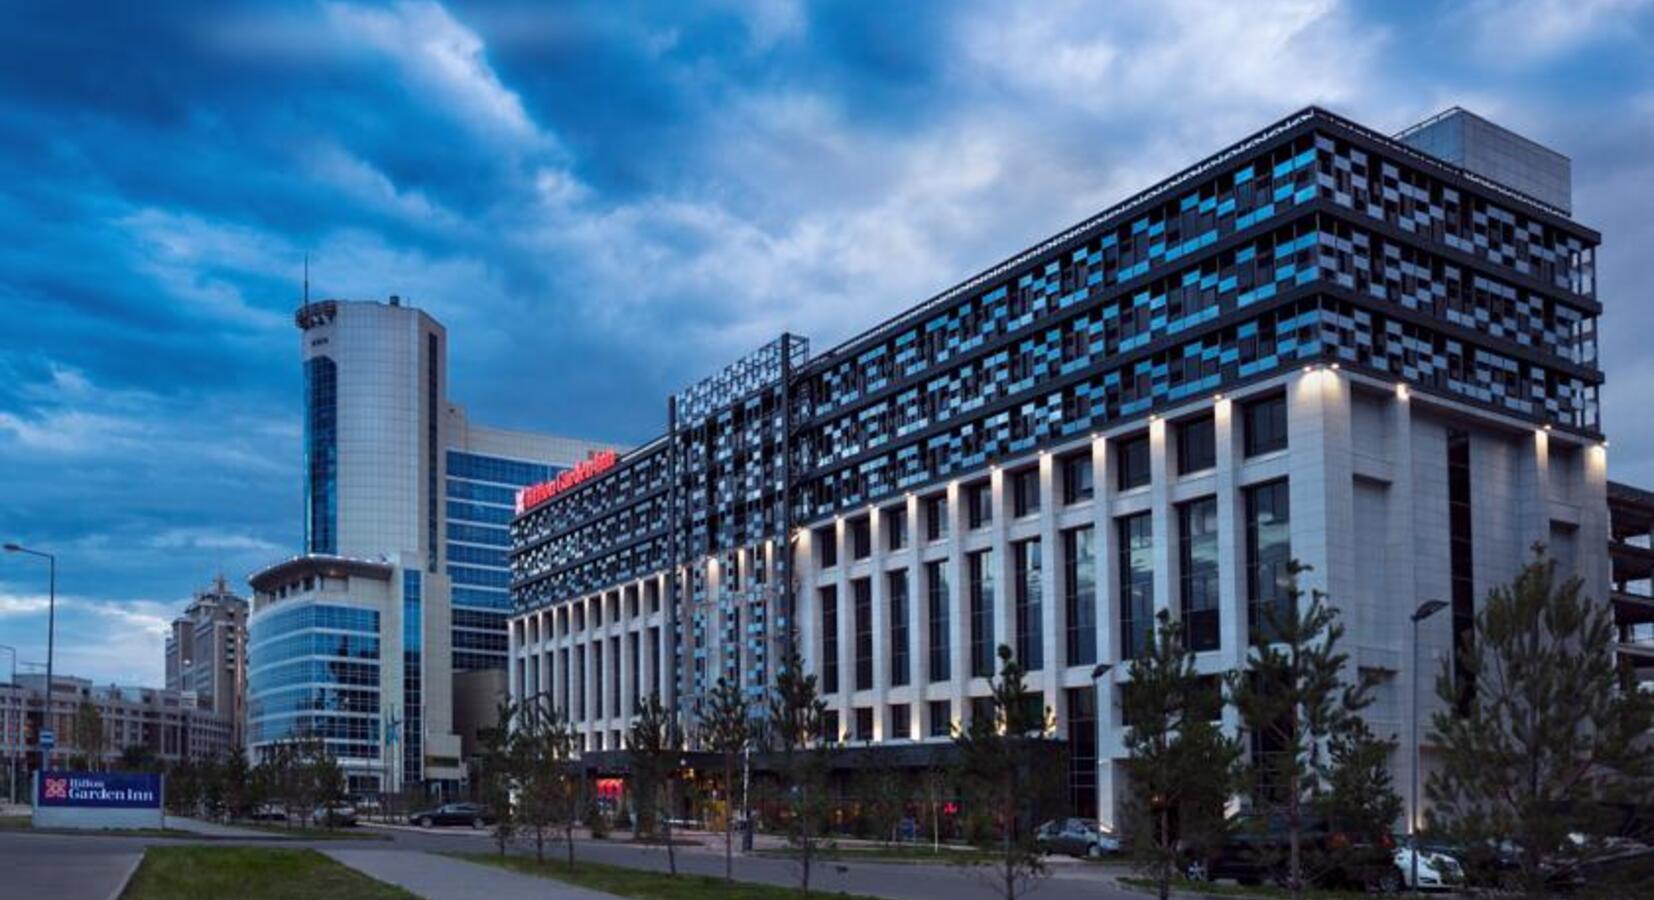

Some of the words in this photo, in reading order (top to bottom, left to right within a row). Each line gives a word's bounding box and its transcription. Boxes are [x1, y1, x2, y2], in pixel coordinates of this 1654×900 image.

[69, 778, 105, 788] Hilton
[68, 788, 125, 800] Garden
[127, 788, 153, 801] Inn
